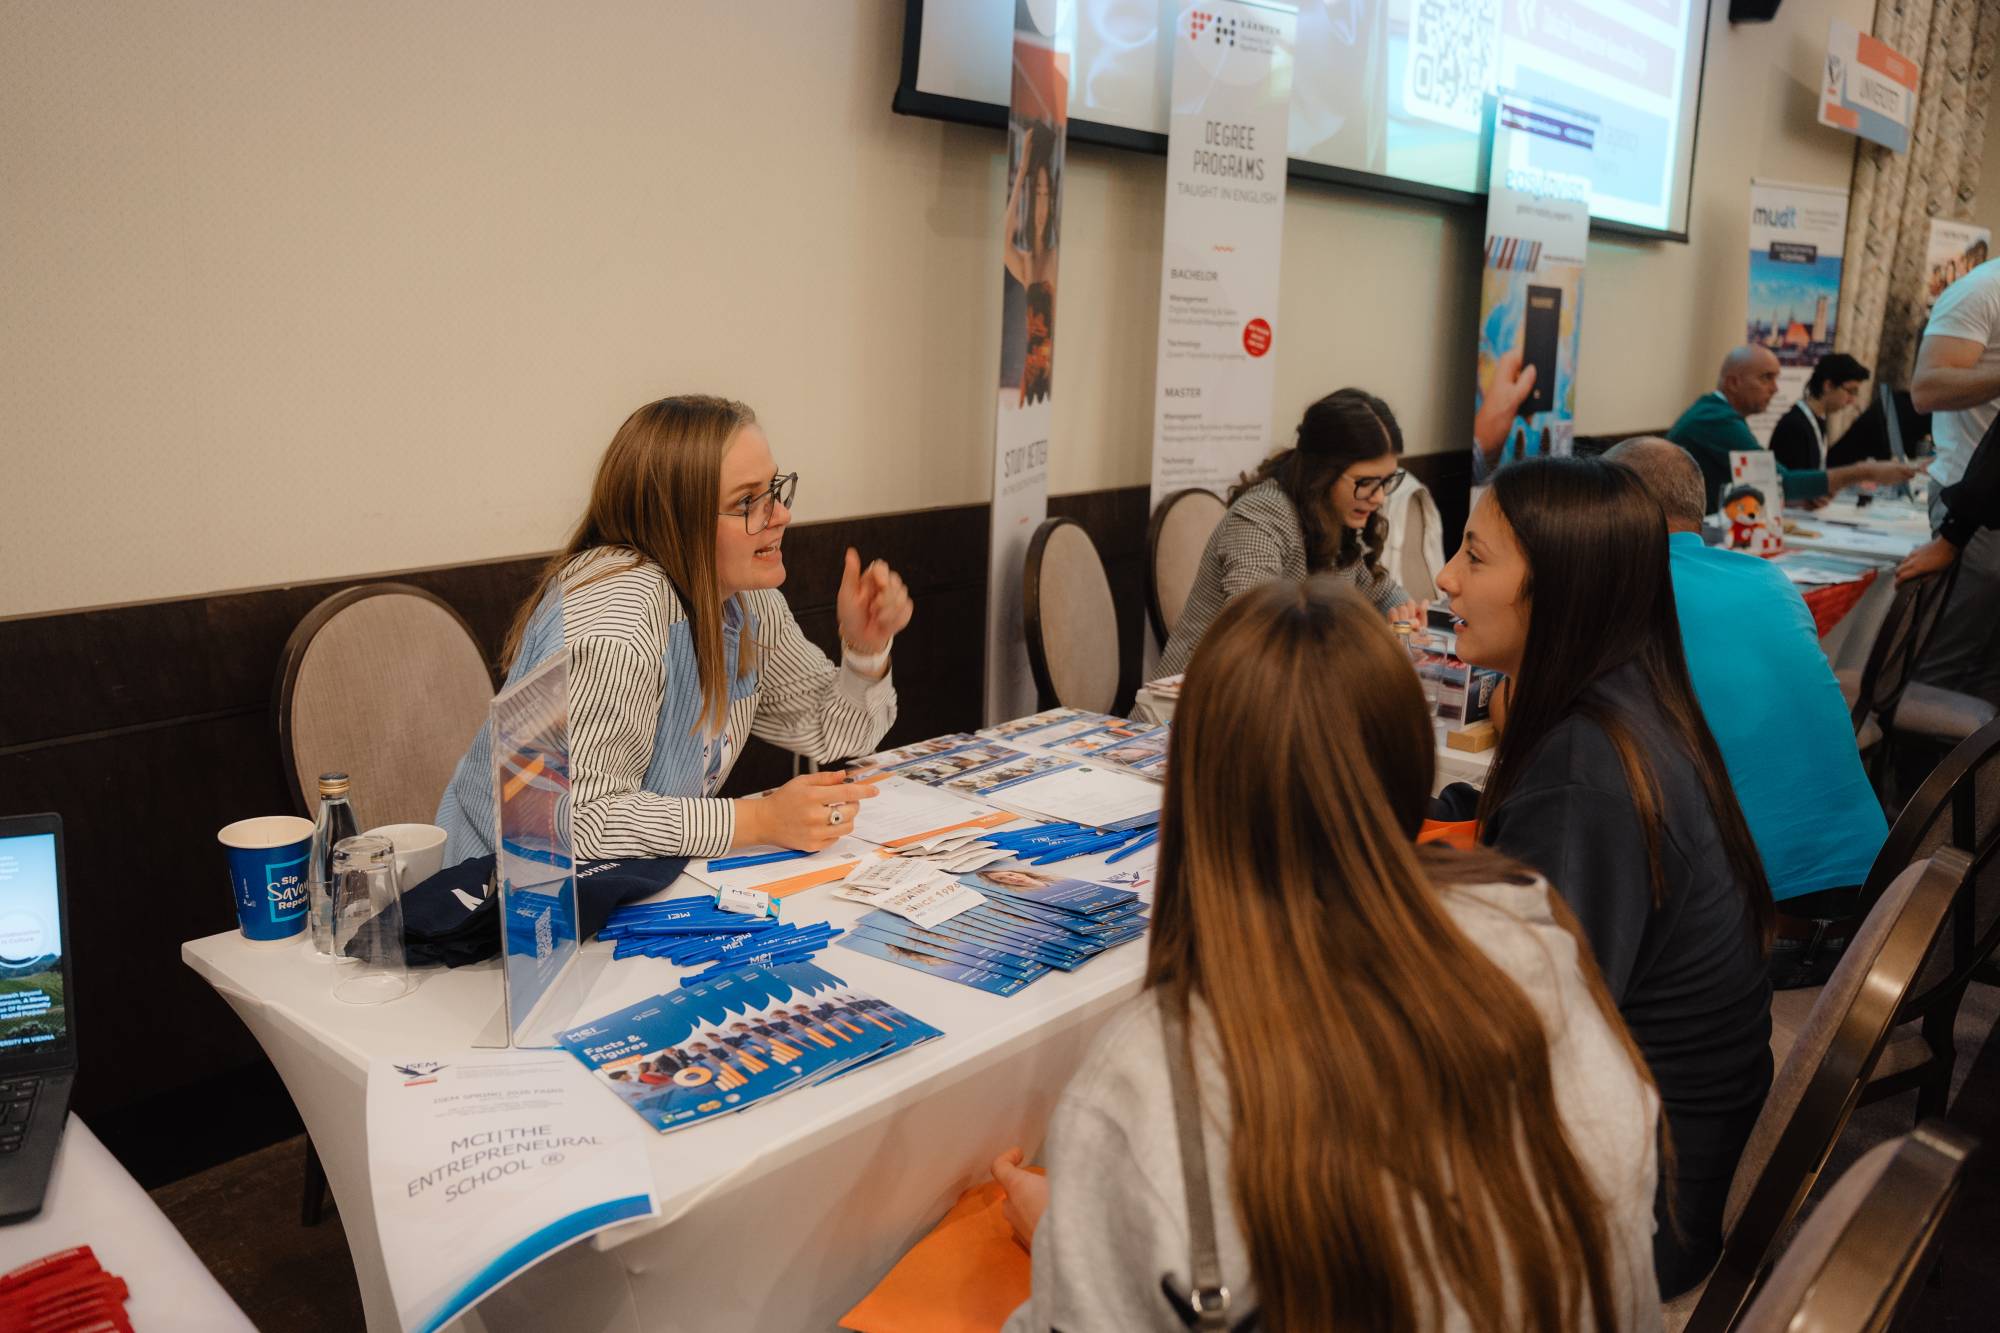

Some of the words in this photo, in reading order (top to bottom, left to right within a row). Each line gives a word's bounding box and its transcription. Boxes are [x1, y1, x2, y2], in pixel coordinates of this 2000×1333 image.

[1205, 120, 1255, 151] DEGREE
[1193, 150, 1264, 181] PROGRAMS
[1177, 181, 1218, 199] TAUGHT
[1221, 186, 1231, 200] IN
[1233, 188, 1277, 205] ENGLISH
[1170, 268, 1218, 281] BACHELOR
[1165, 387, 1201, 399] MASTER
[281, 875, 299, 886] Sip
[576, 861, 621, 879] AUSTRIA
[31, 1033, 56, 1044] VIENNA
[583, 1039, 626, 1056] Facts
[627, 1034, 642, 1044] &
[589, 1040, 649, 1063] Figures
[407, 1135, 604, 1199] ENTREPRENEURAL
[444, 1158, 533, 1203] SCHOOL
